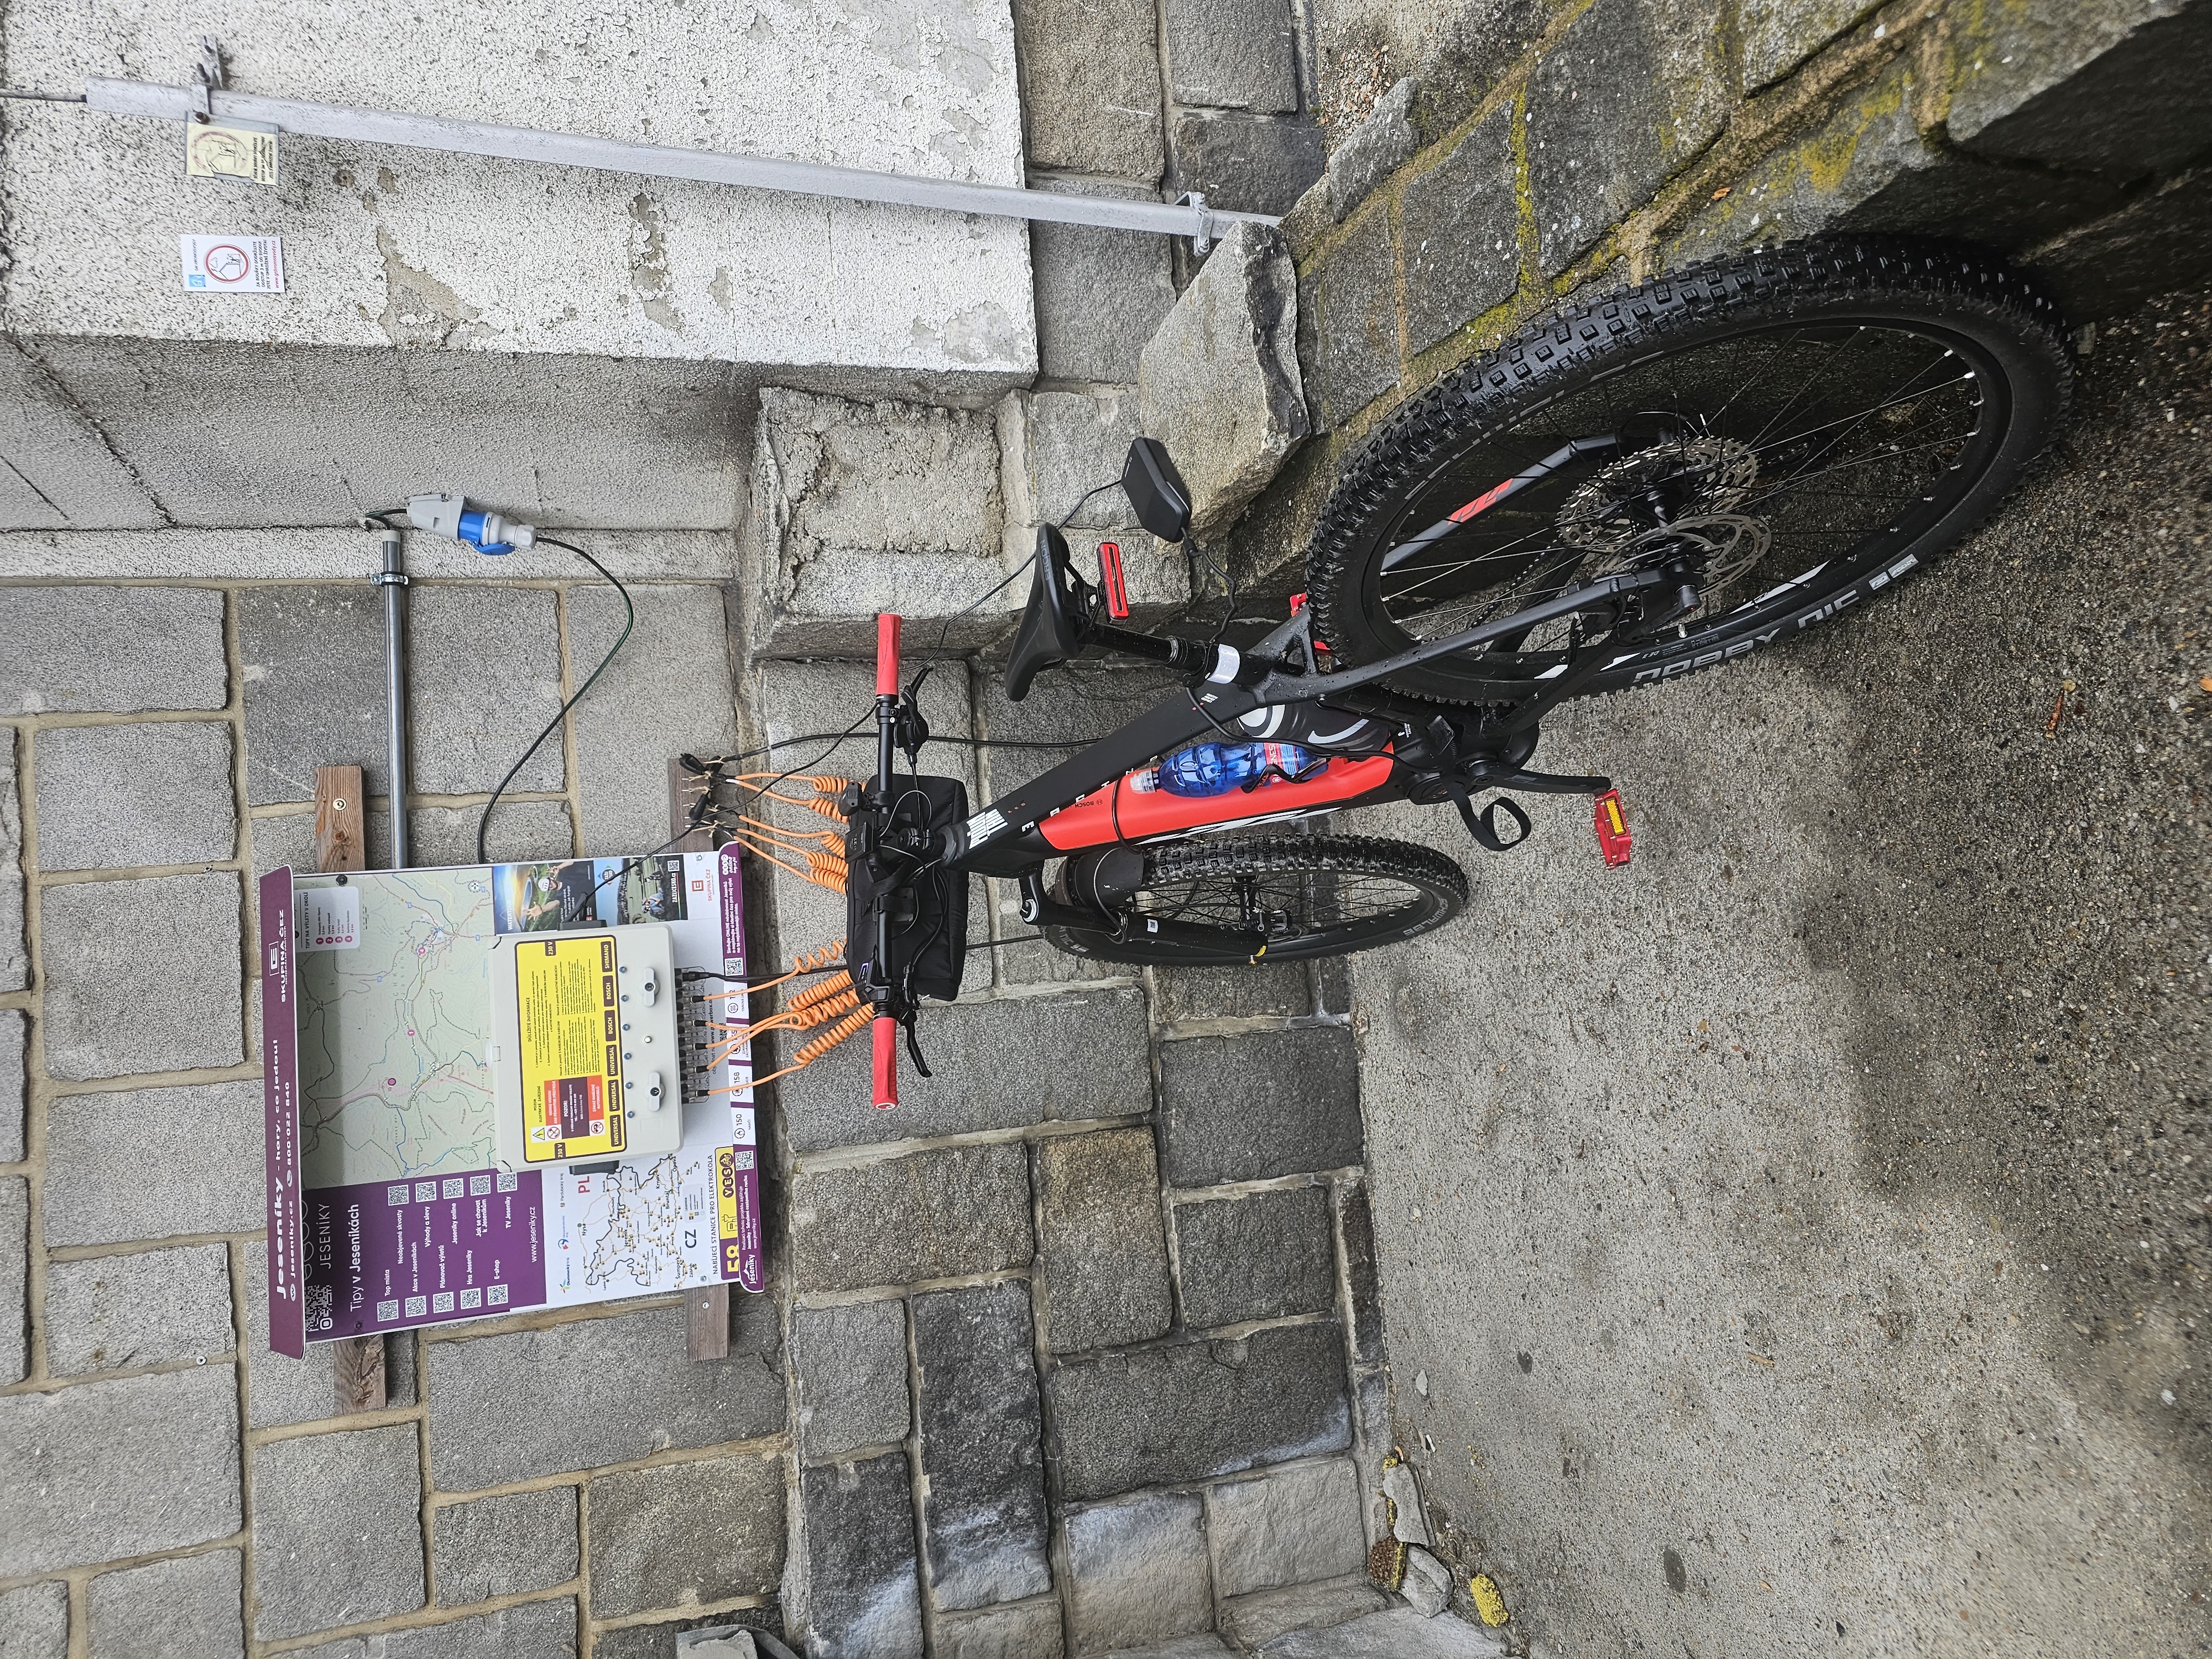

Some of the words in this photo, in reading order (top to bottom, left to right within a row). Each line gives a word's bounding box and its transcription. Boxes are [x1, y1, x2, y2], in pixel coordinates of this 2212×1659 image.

[1040, 539, 1051, 581] ERGON
[1634, 627, 1781, 684] NOBBY
[1797, 589, 1860, 629] NIC
[1074, 801, 1094, 809] BOSCH
[1402, 897, 1448, 936] SCHWALBE
[275, 1095, 279, 1113] co
[578, 1176, 590, 1194] PL
[724, 1169, 732, 1196] YES
[274, 1177, 286, 1300] Jeseníky
[316, 1204, 331, 1269] JESENÍKY
[529, 1207, 538, 1262] www.jeseniky.cz
[685, 1229, 697, 1249] CZ
[726, 1245, 739, 1272] 58
[747, 1254, 757, 1284] Jeseníky
[350, 1286, 364, 1312] Tipy
